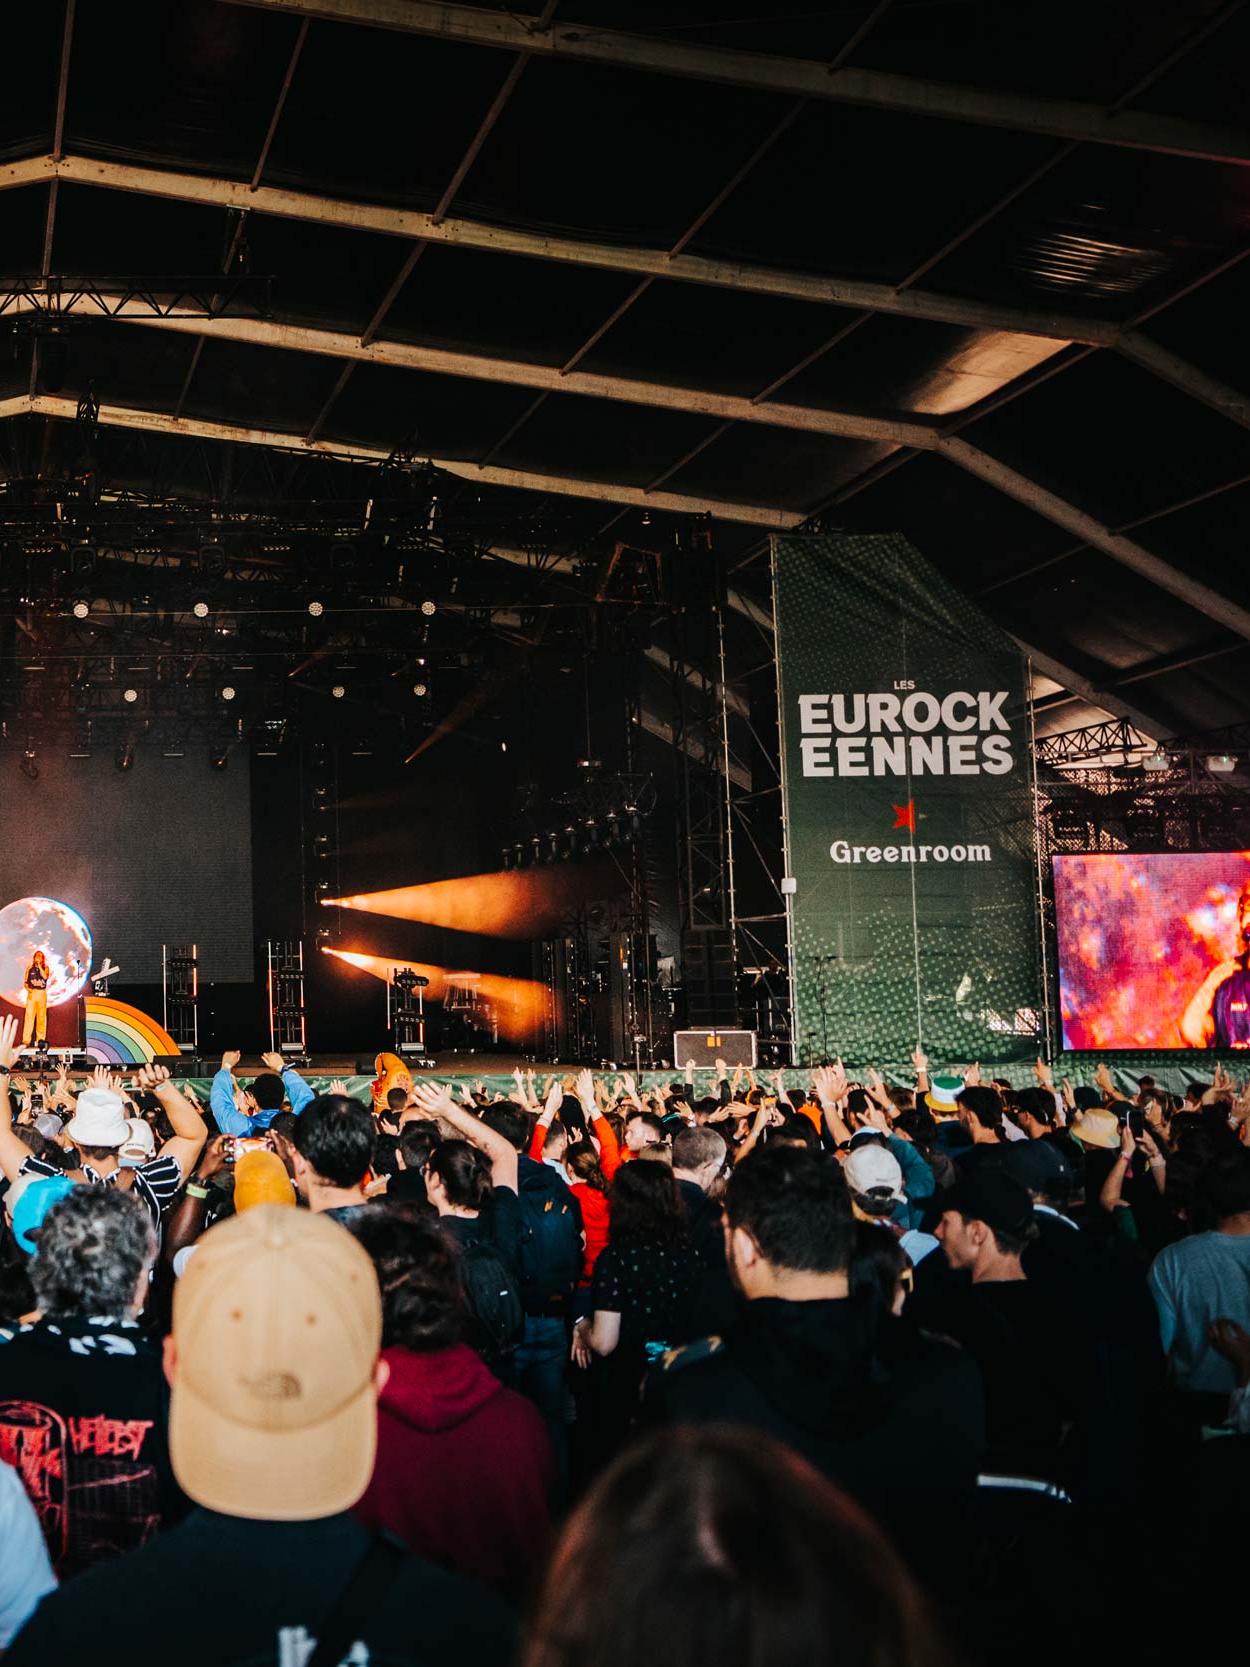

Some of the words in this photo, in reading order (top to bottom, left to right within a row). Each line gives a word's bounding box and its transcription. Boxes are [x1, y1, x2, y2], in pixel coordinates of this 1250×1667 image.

[893, 680, 916, 690] LES
[798, 691, 1012, 734] EUROCK
[800, 734, 1014, 777] EENNES
[829, 840, 992, 864] Greenroom
